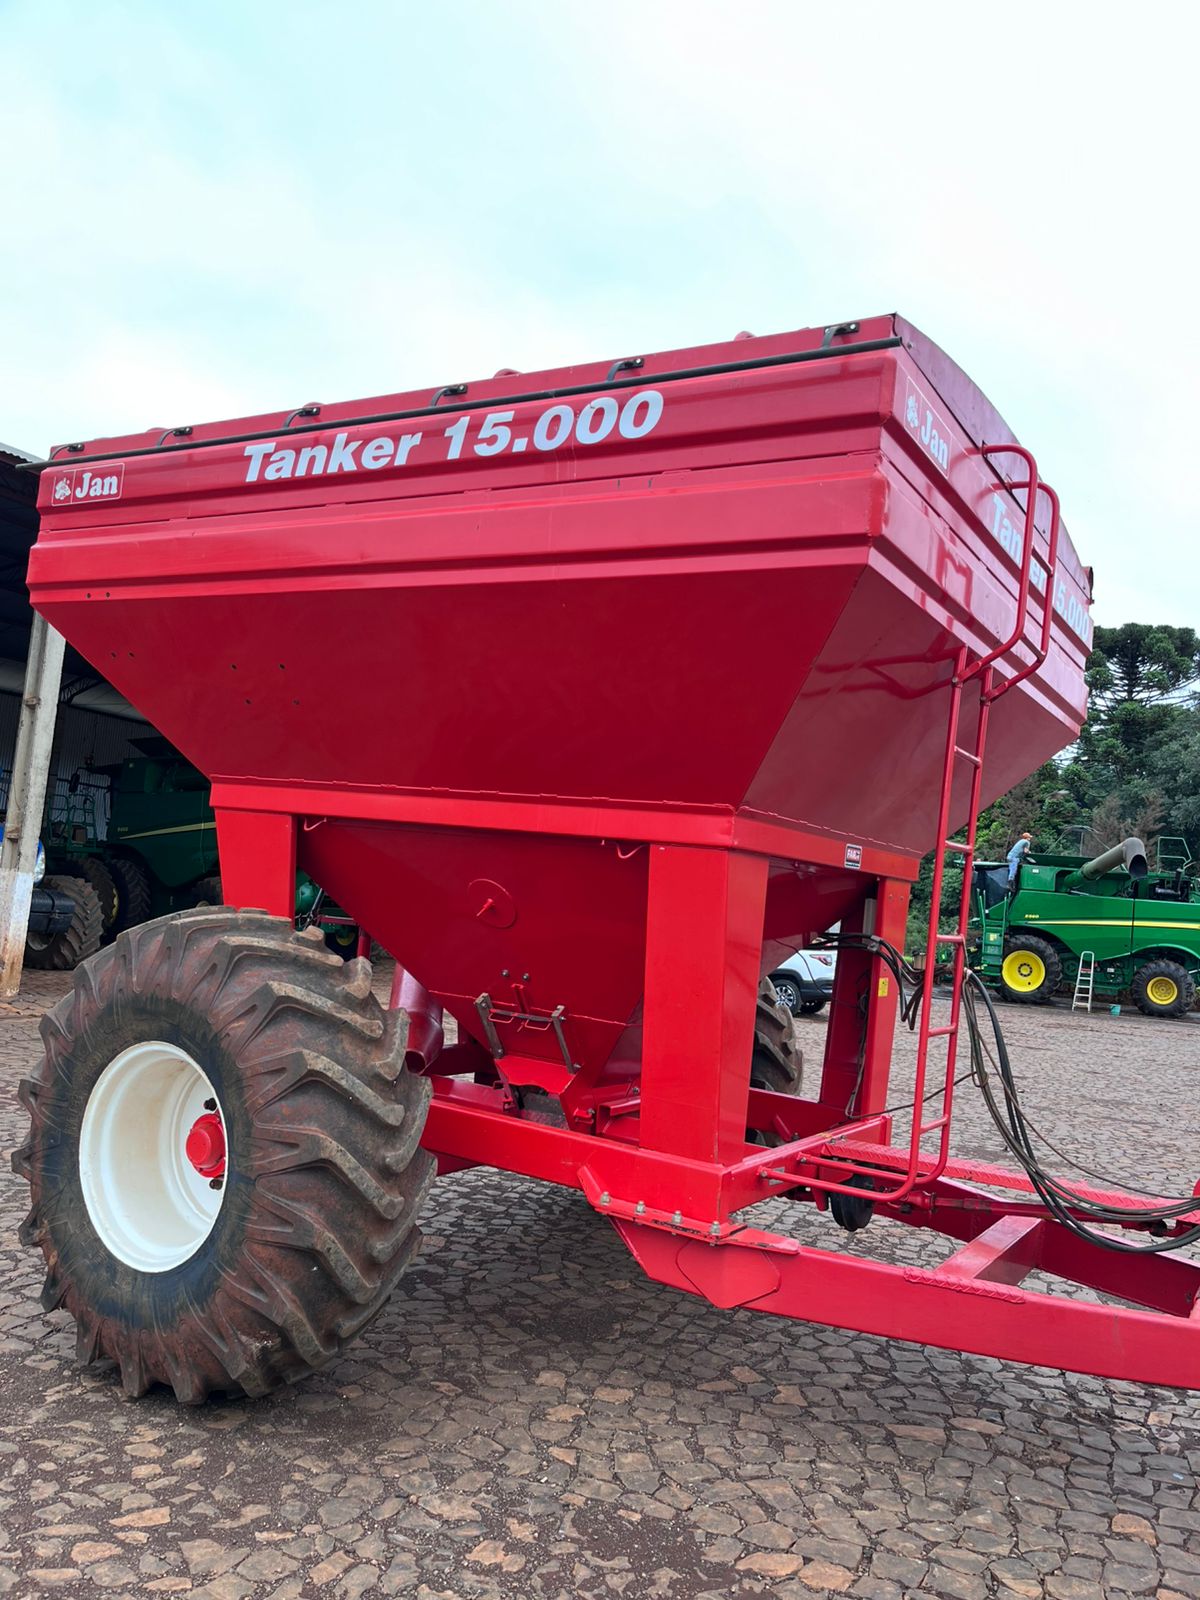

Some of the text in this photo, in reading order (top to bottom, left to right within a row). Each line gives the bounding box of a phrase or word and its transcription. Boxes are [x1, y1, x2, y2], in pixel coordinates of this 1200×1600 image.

[243, 390, 664, 482] Tanker 15.000
[921, 410, 948, 470] Jan
[75, 472, 118, 498] Jan
[992, 494, 1090, 642] Taner 5.000
